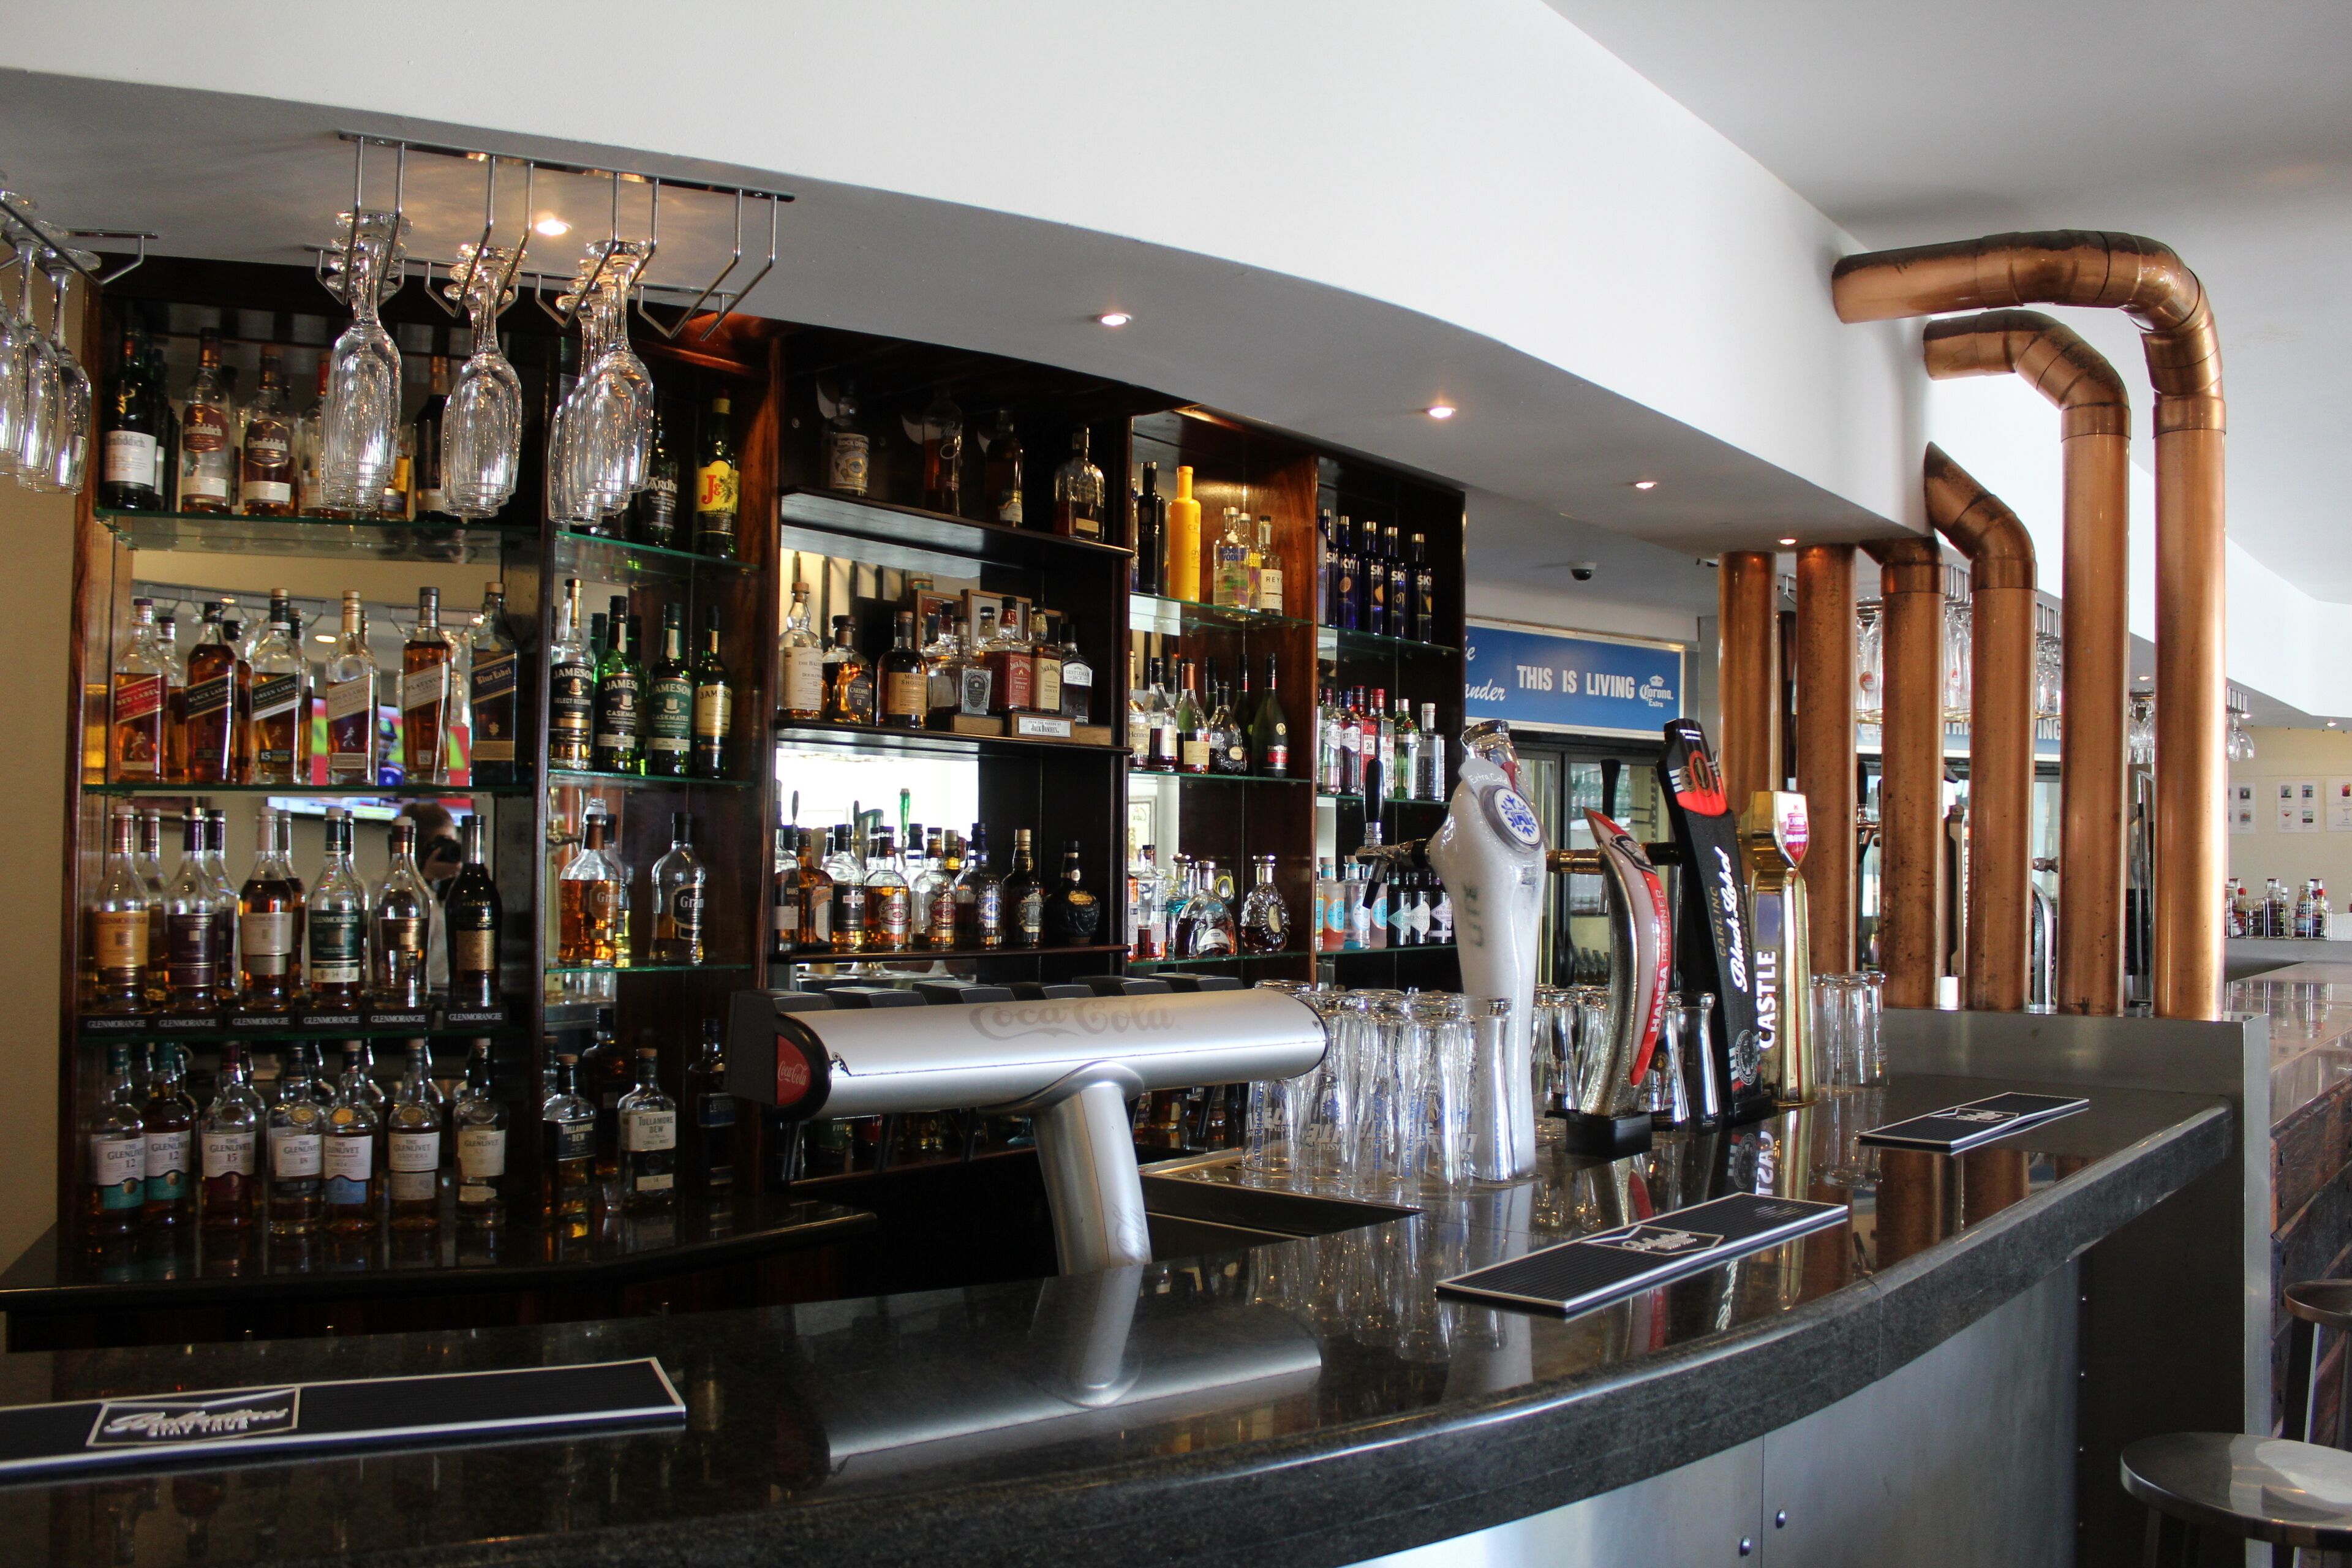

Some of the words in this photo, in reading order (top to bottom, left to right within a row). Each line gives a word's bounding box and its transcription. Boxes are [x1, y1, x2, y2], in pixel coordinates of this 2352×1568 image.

[701, 474, 723, 505] J&
[476, 673, 492, 685] Blue
[492, 667, 512, 679] Label
[553, 668, 593, 682] JAMESON
[1517, 665, 1553, 691] THIS
[1562, 670, 1577, 693] IS
[1586, 673, 1635, 699] LIVING
[254, 688, 276, 699] GREEN
[277, 682, 297, 693] LABEL
[850, 687, 869, 695] CARDHU
[1648, 699, 1664, 708] Extra
[1031, 724, 1041, 733] JACK
[1468, 773, 1489, 784] Extra
[1490, 773, 1507, 784] Cold
[597, 892, 619, 903] Gran
[680, 895, 704, 908] Gran
[312, 915, 359, 924] GLENMORANGIE
[1710, 886, 1727, 957] CARLING
[1737, 884, 1752, 957] DRAUGHT
[1655, 889, 1670, 962] PILSENER
[1650, 966, 1668, 1033] HANSA
[1756, 951, 1776, 1049] CASTLE
[232, 1017, 290, 1026] GLENMORANGIE
[303, 1015, 360, 1025] GLENMORANGIE
[371, 1014, 426, 1023] GLENMORANGIE
[448, 1012, 503, 1021] GLENMORANGIE
[88, 1019, 146, 1028] GLENMORANGIE
[159, 1019, 217, 1027] GLENMORANGIE
[638, 1116, 674, 1127] TULLAMORE
[562, 1122, 594, 1134] TULLAMORE
[649, 1126, 664, 1134] DEW
[168, 1151, 179, 1160] 12
[227, 1153, 237, 1162] 15
[126, 1159, 136, 1168] 12
[195, 1416, 249, 1433] TRUE
